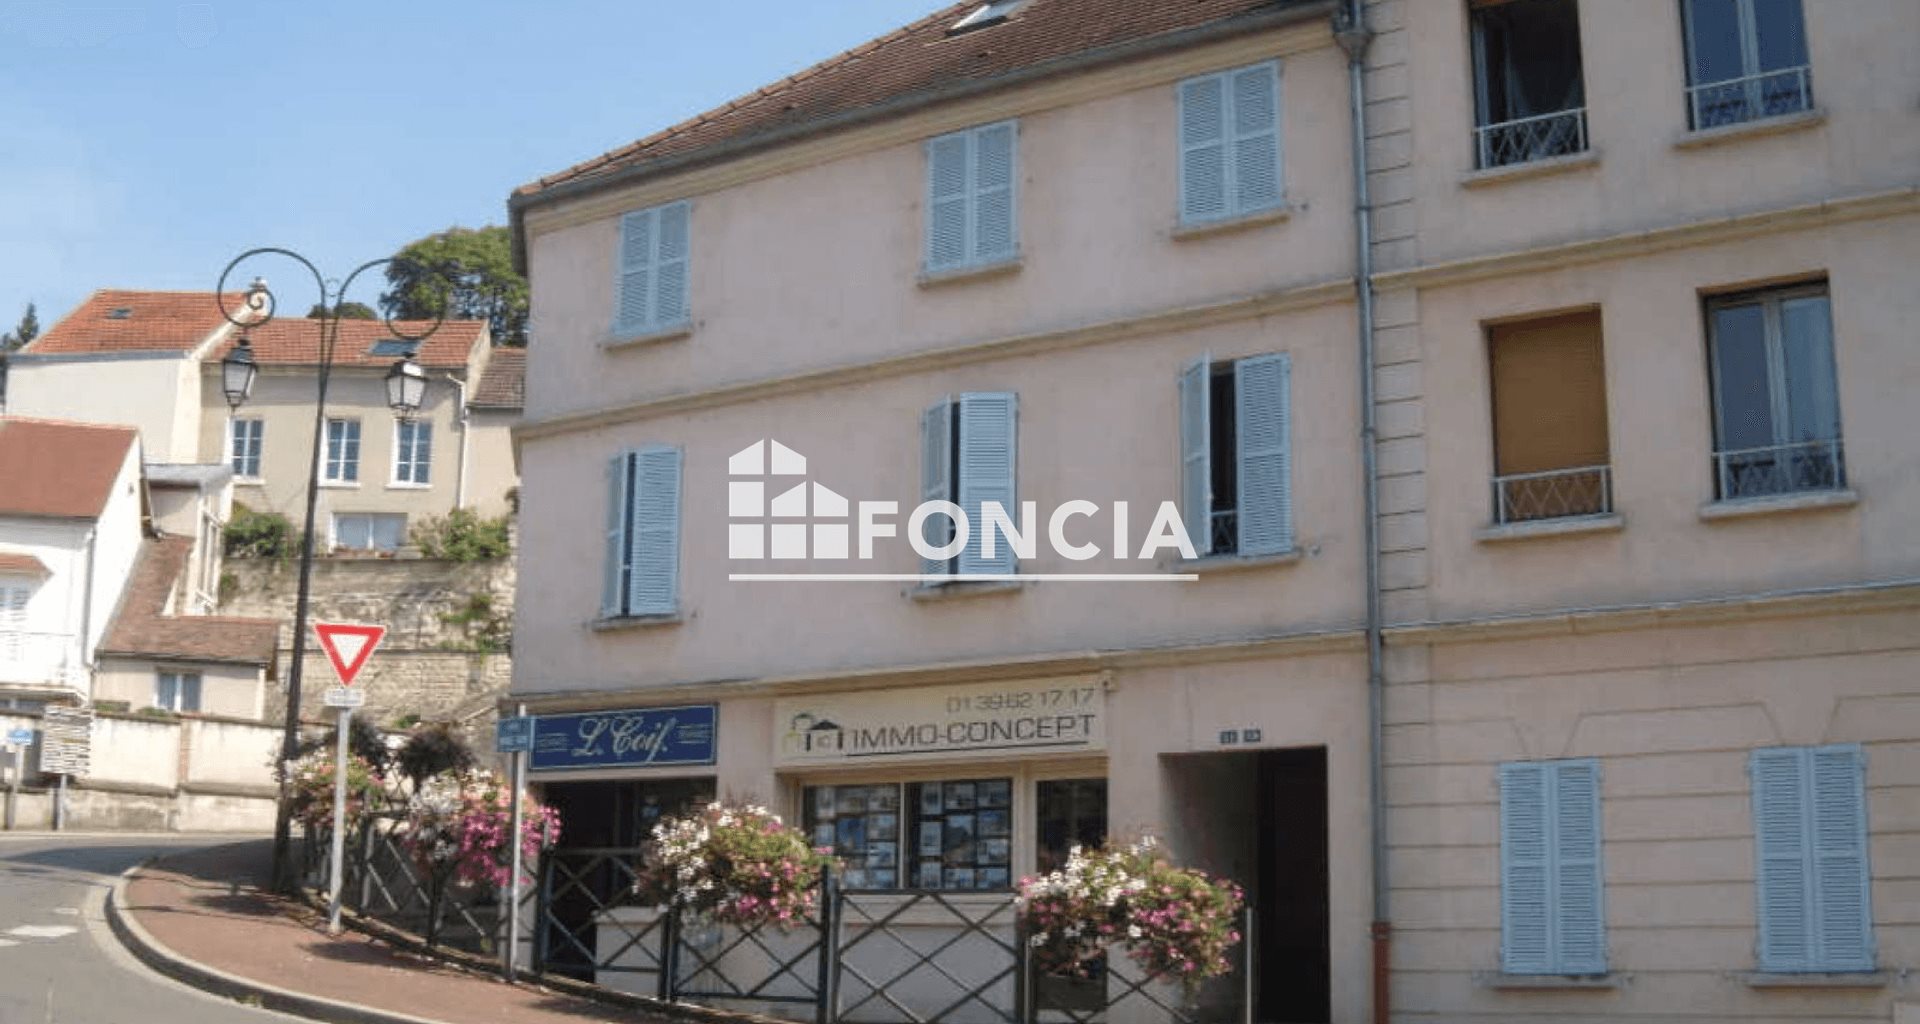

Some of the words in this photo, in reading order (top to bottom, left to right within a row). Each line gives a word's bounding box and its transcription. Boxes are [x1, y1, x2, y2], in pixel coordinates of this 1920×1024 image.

[1040, 689, 1063, 705] 17
[1070, 687, 1095, 705] 17
[852, 714, 1096, 750] IMMO-CONCEPT
